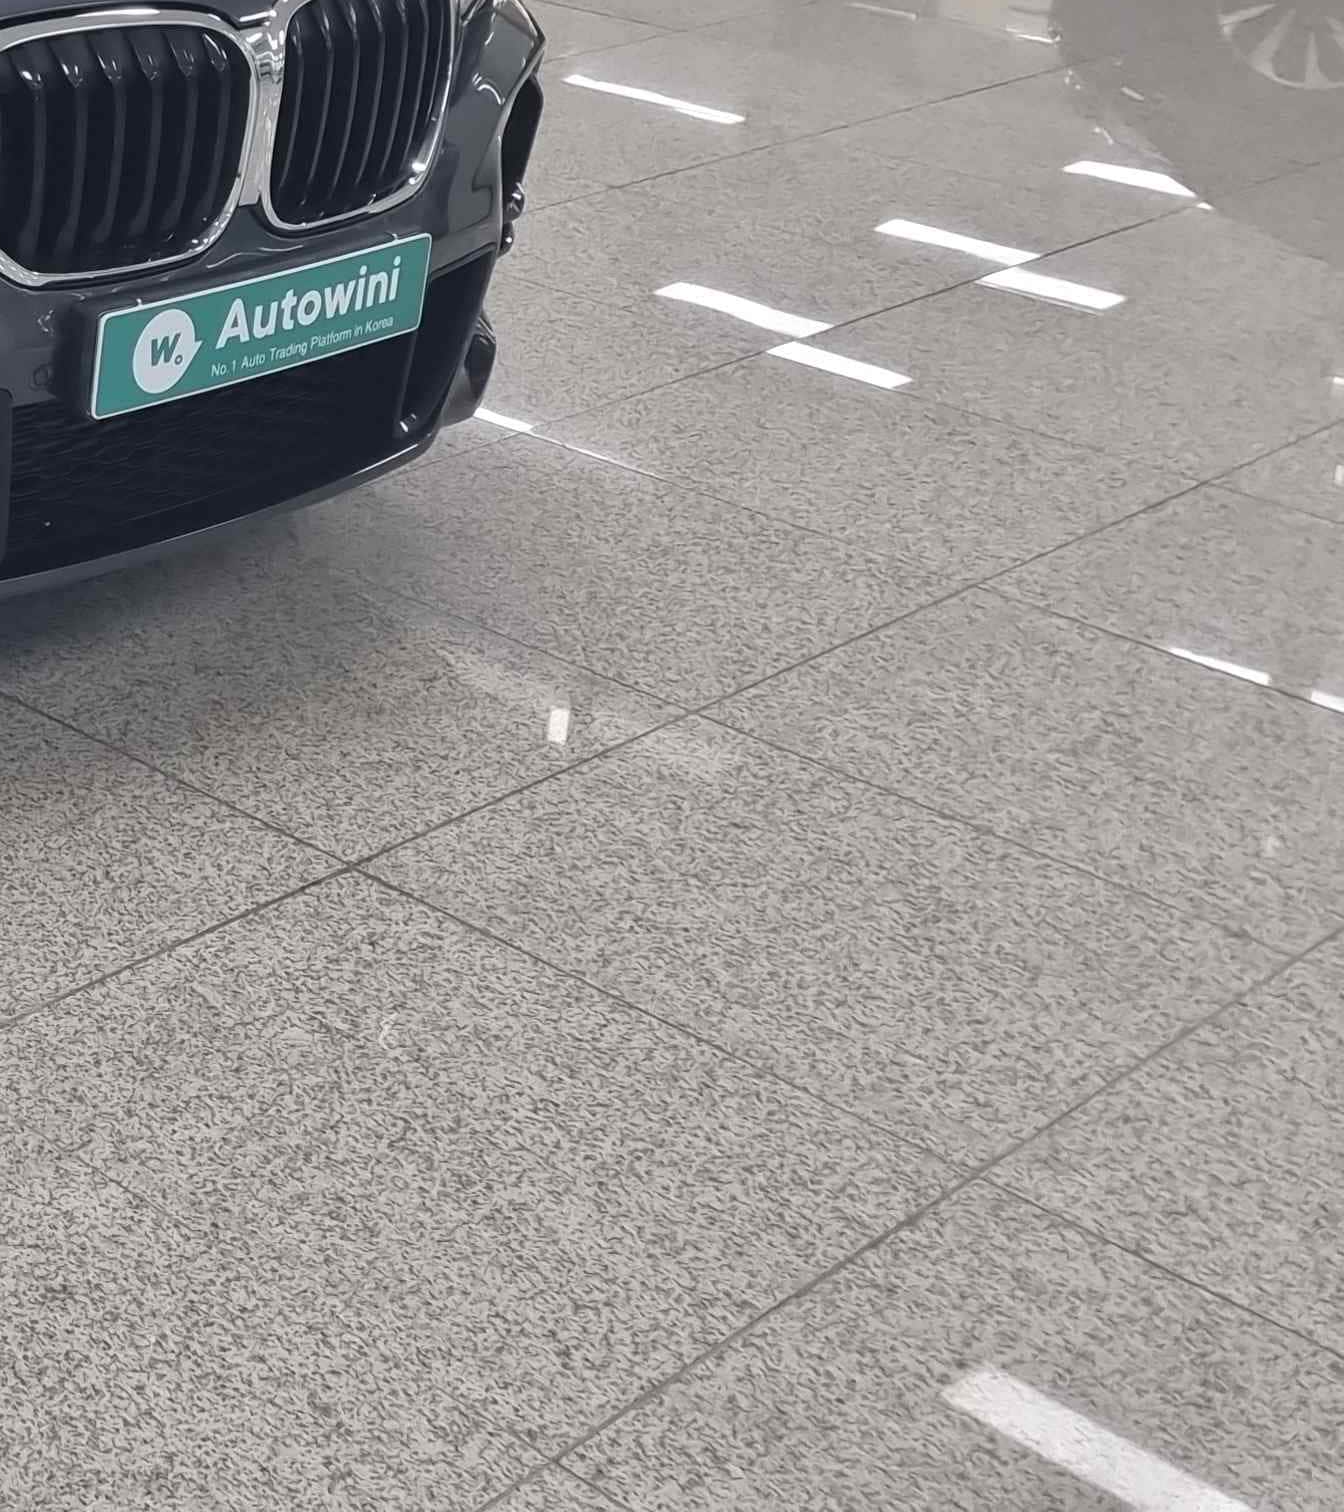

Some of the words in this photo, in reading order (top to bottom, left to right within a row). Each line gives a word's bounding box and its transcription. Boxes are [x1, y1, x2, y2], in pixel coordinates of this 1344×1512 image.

[216, 256, 401, 349] Autowini
[241, 353, 266, 369] Auto
[270, 342, 308, 361] Trading
[310, 329, 352, 352] Platform
[353, 324, 363, 337] in
[365, 316, 394, 334] Korea
